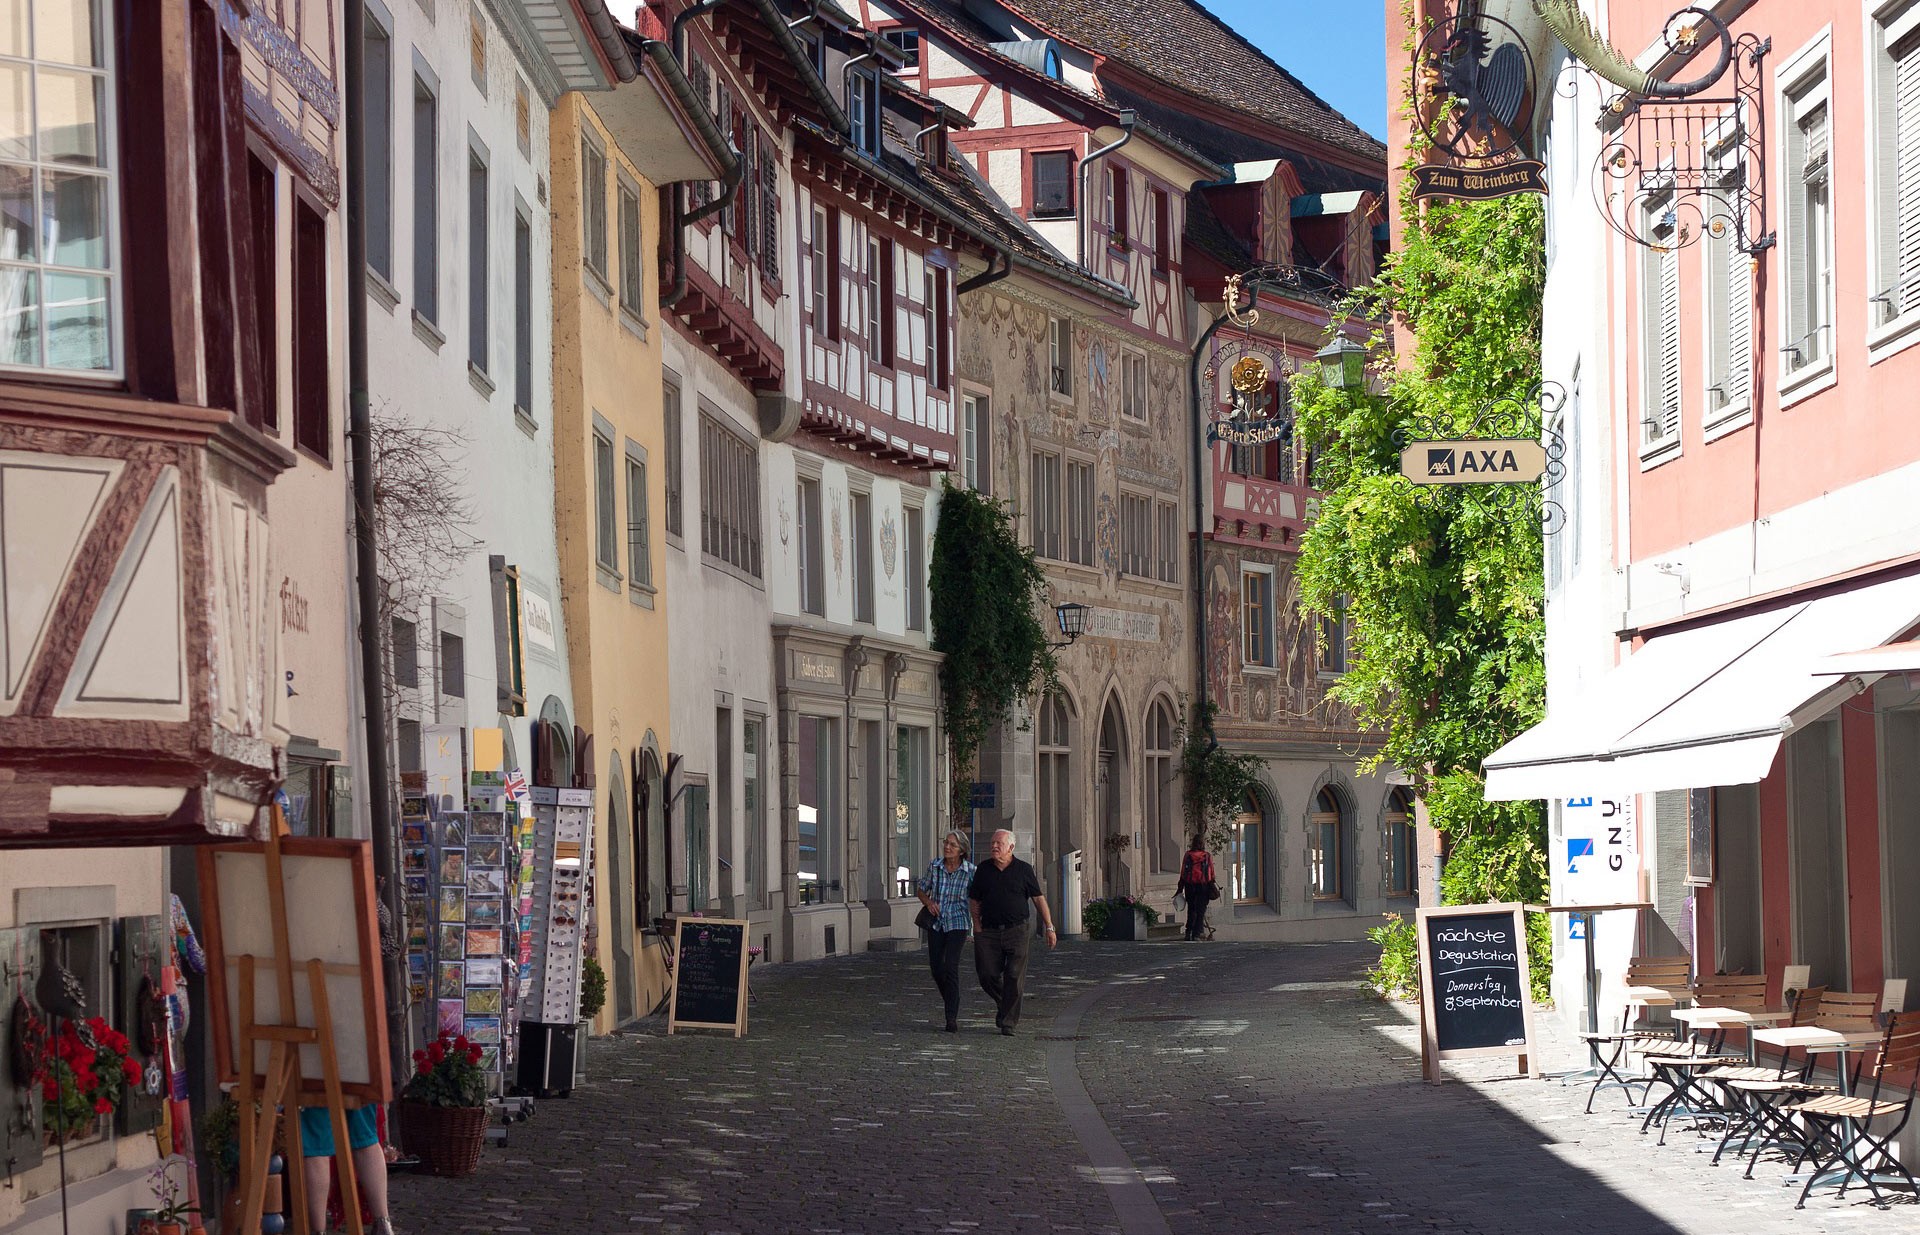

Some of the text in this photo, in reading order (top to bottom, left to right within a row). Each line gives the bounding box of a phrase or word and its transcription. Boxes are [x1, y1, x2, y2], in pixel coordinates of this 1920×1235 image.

[1429, 170, 1530, 190] Zum Weinberg
[1428, 462, 1451, 474] AXA
[1460, 449, 1519, 473] AXA
[1439, 949, 1516, 964] Degustation
